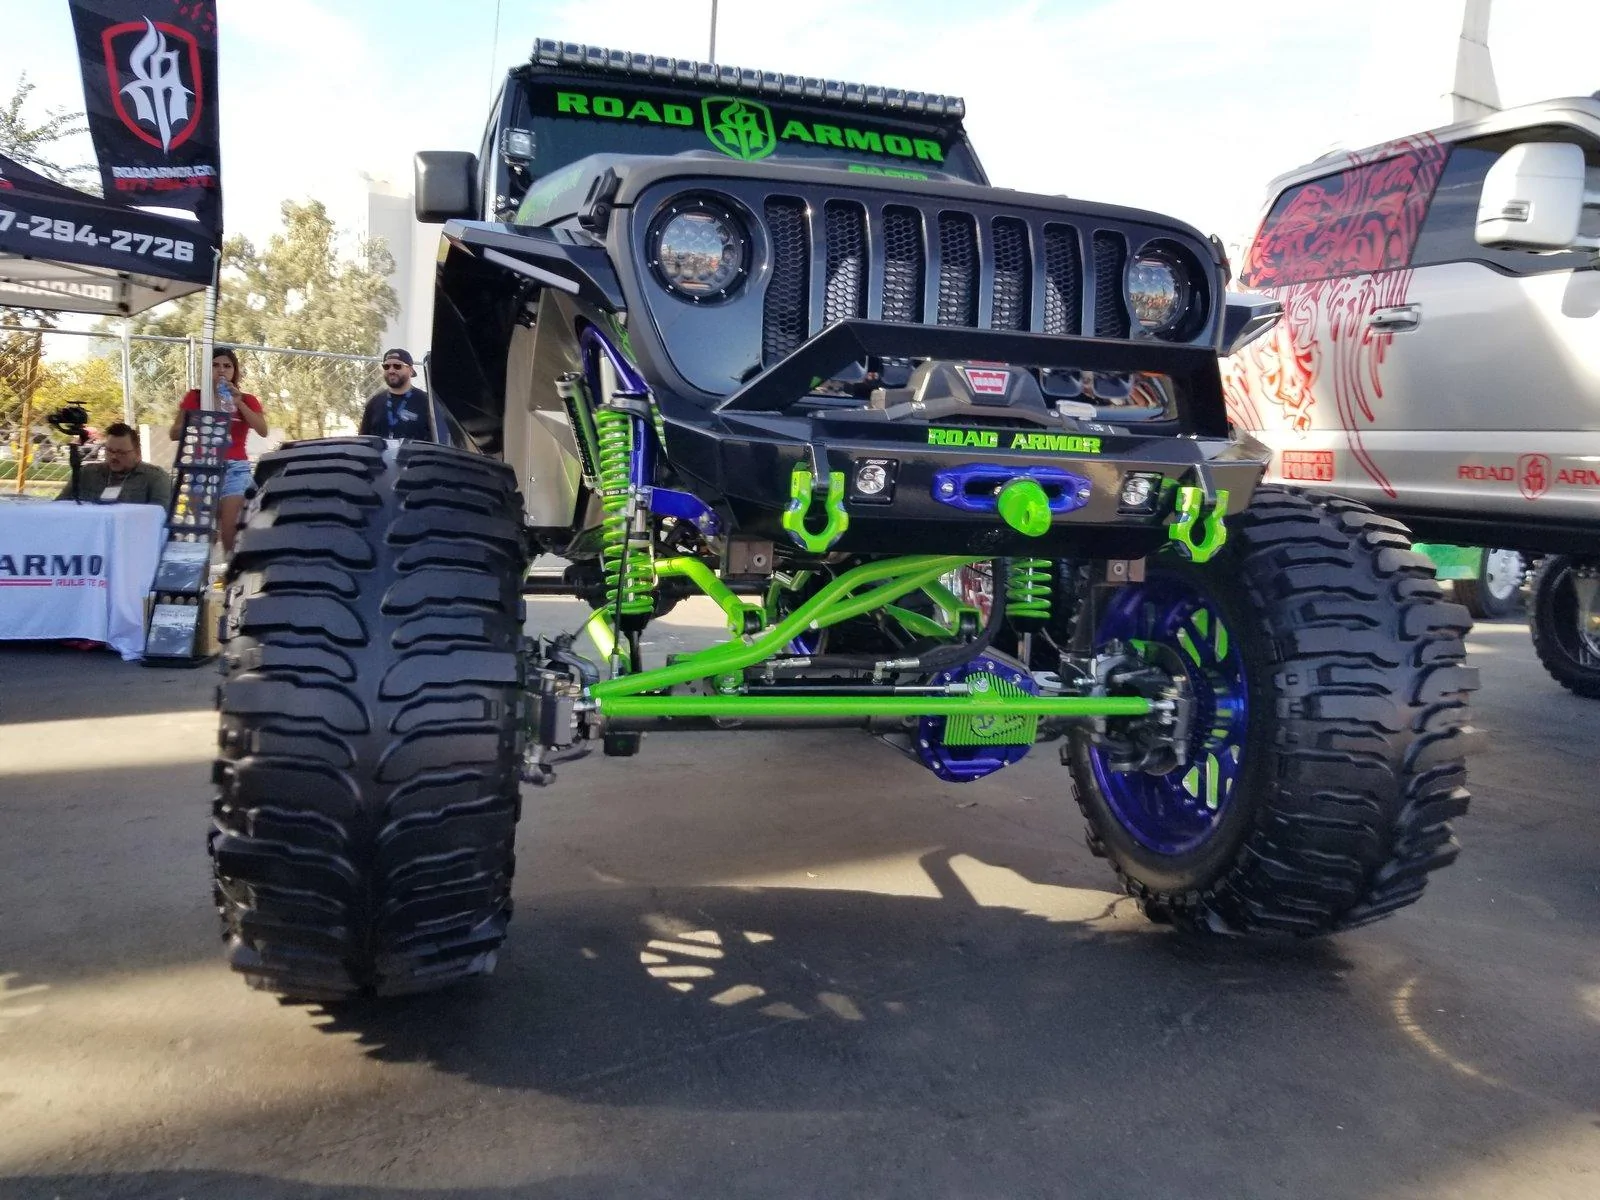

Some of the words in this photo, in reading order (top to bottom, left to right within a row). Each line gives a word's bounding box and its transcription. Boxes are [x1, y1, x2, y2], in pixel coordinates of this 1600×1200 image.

[557, 91, 694, 126] ROAD
[780, 120, 944, 162] ARMOR
[0, 209, 195, 262] 7-294-2726
[928, 428, 998, 448] ROAD
[1010, 432, 1102, 454] ARMOR
[1458, 465, 1514, 481] ROAD
